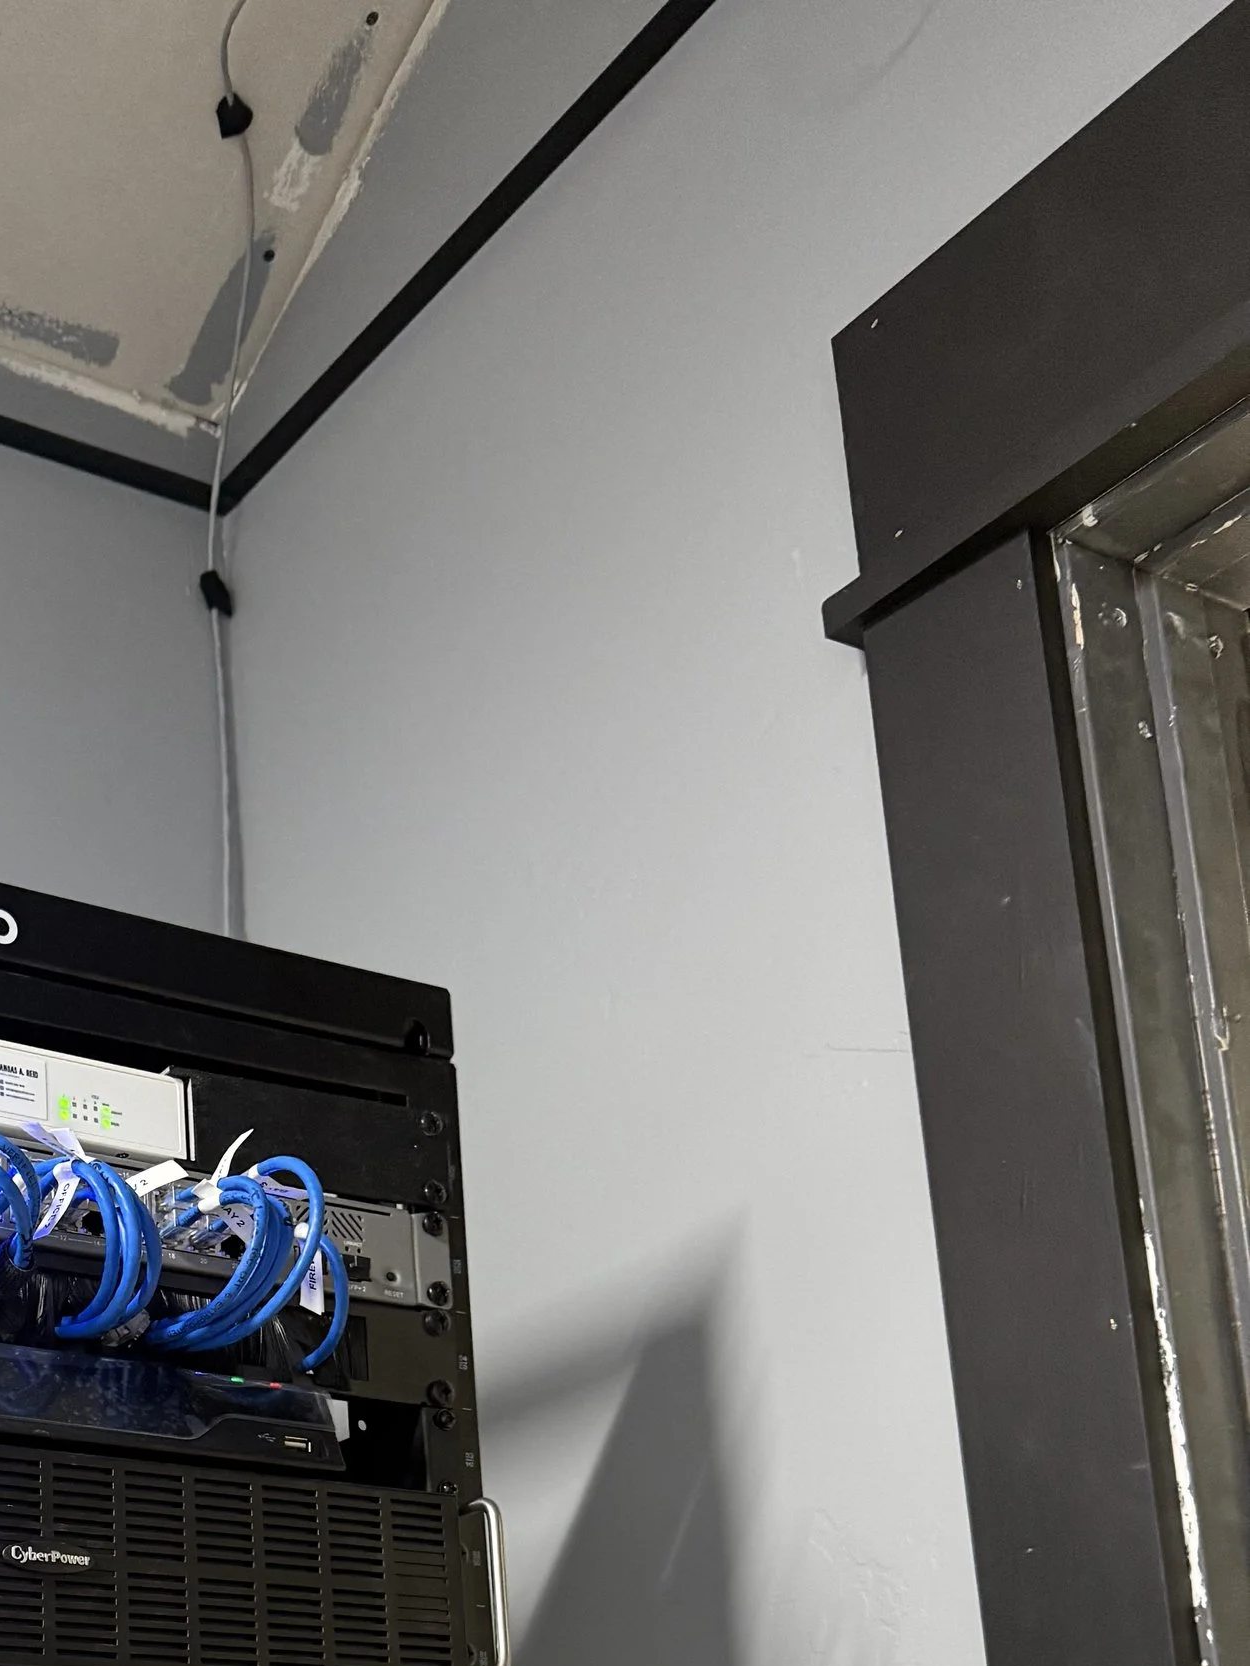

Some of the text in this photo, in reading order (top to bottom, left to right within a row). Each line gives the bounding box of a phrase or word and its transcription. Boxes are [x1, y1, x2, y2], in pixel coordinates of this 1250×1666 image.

[53, 1183, 70, 1221] OFFICE
[221, 1205, 245, 1228] AY 2
[11, 1545, 91, 1566] CyberPower
